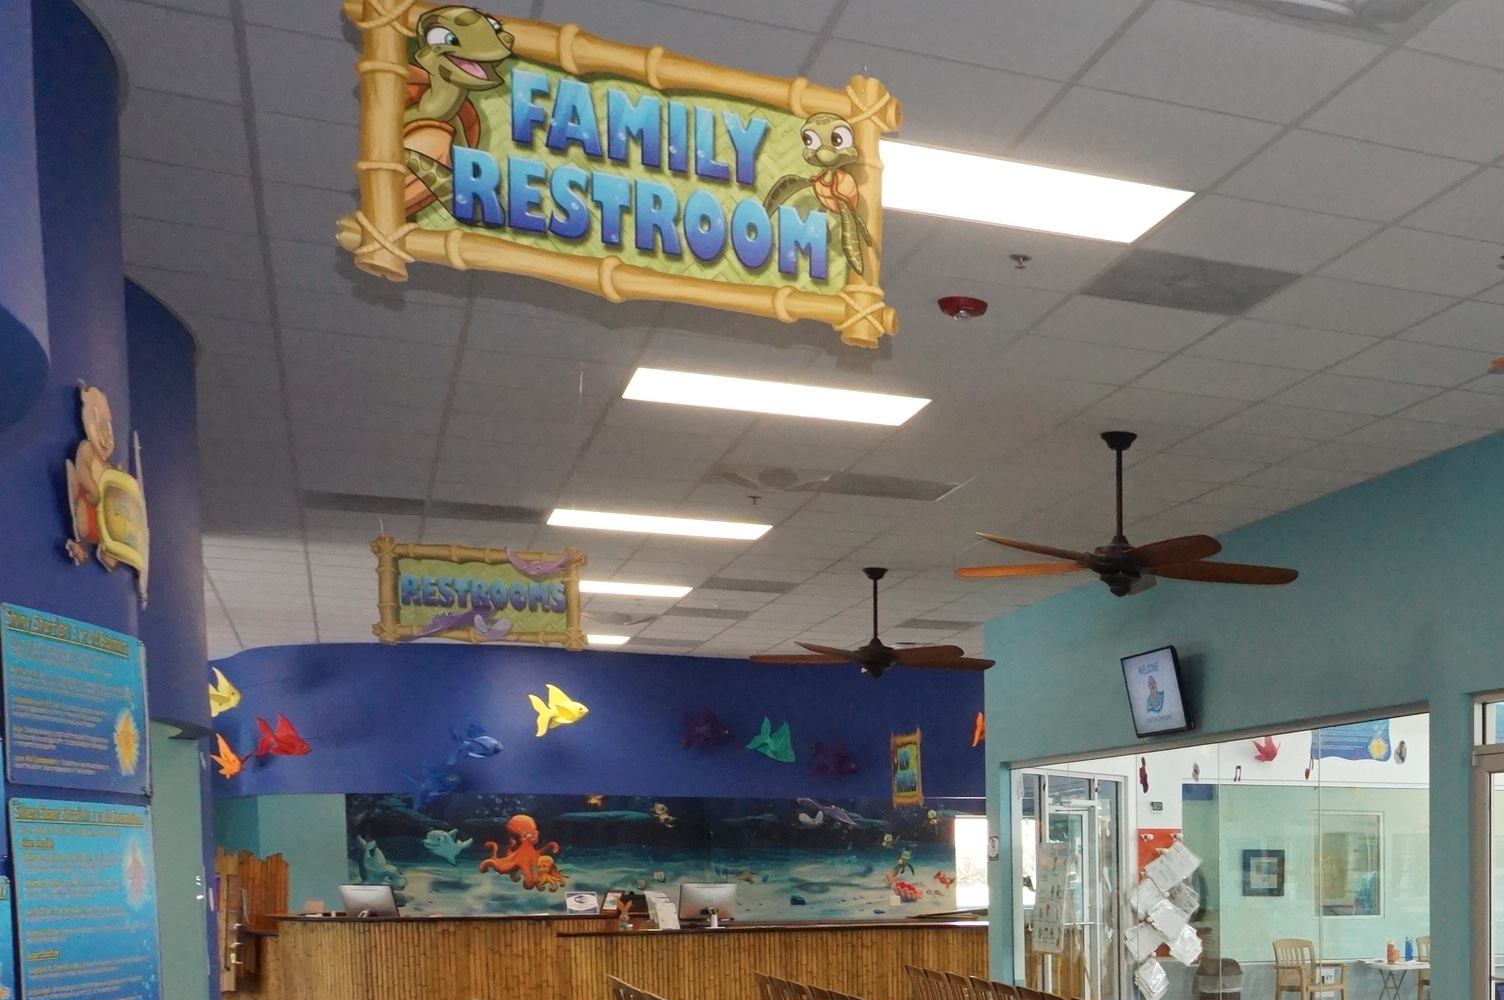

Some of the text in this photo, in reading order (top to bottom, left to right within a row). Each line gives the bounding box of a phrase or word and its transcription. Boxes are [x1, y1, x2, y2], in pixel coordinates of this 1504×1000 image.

[510, 67, 769, 186] FAMILY
[451, 145, 829, 281] RESTROOM
[401, 575, 567, 613] RESTROOMS
